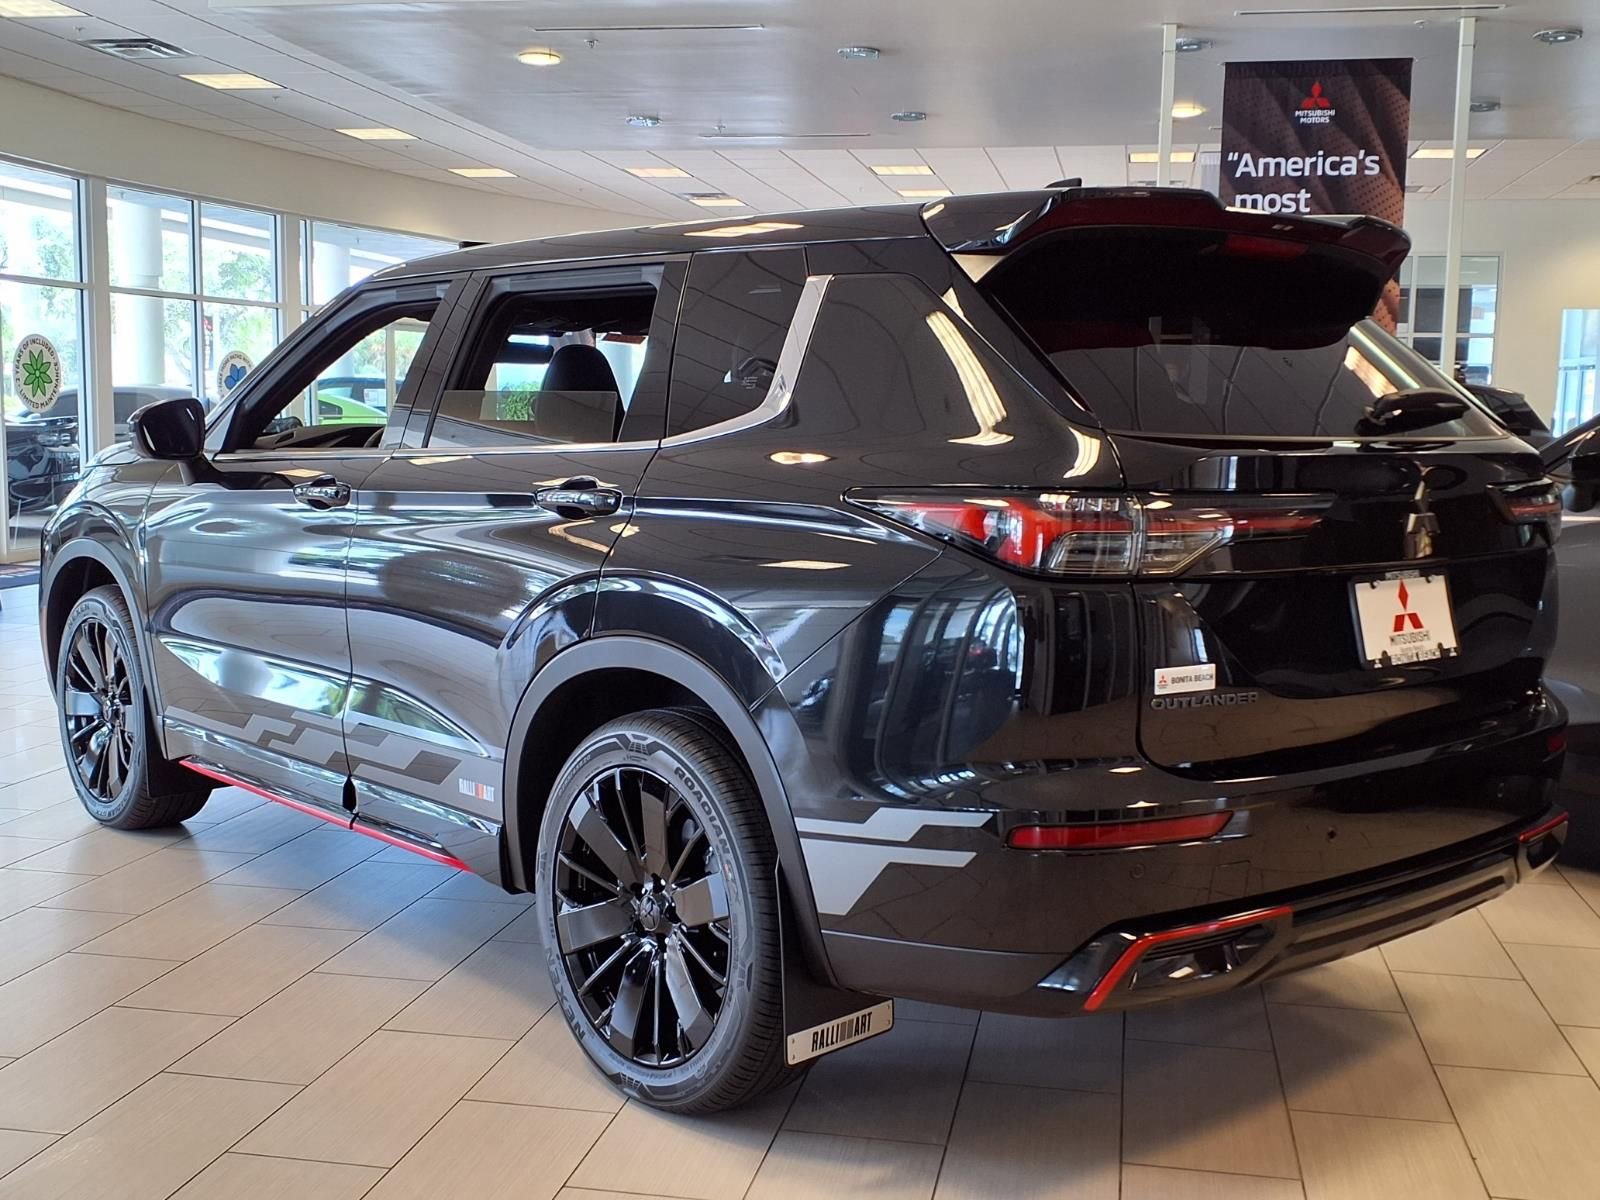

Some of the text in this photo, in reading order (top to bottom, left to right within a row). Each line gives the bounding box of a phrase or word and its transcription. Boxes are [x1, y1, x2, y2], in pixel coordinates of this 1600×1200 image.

[1295, 109, 1336, 117] MITSUBISHI
[1300, 116, 1330, 124] MOTORS
[1235, 188, 1311, 214] most
[15, 348, 24, 374] YEARS
[29, 337, 56, 357] INCLUDED
[19, 361, 60, 409] LIMITED MAINTENANCE
[1389, 630, 1431, 646] MITSUBISHI
[1171, 673, 1214, 685] BONITA BEACH
[1151, 691, 1258, 710] OUTLANDER
[673, 766, 730, 854] ROADIAN
